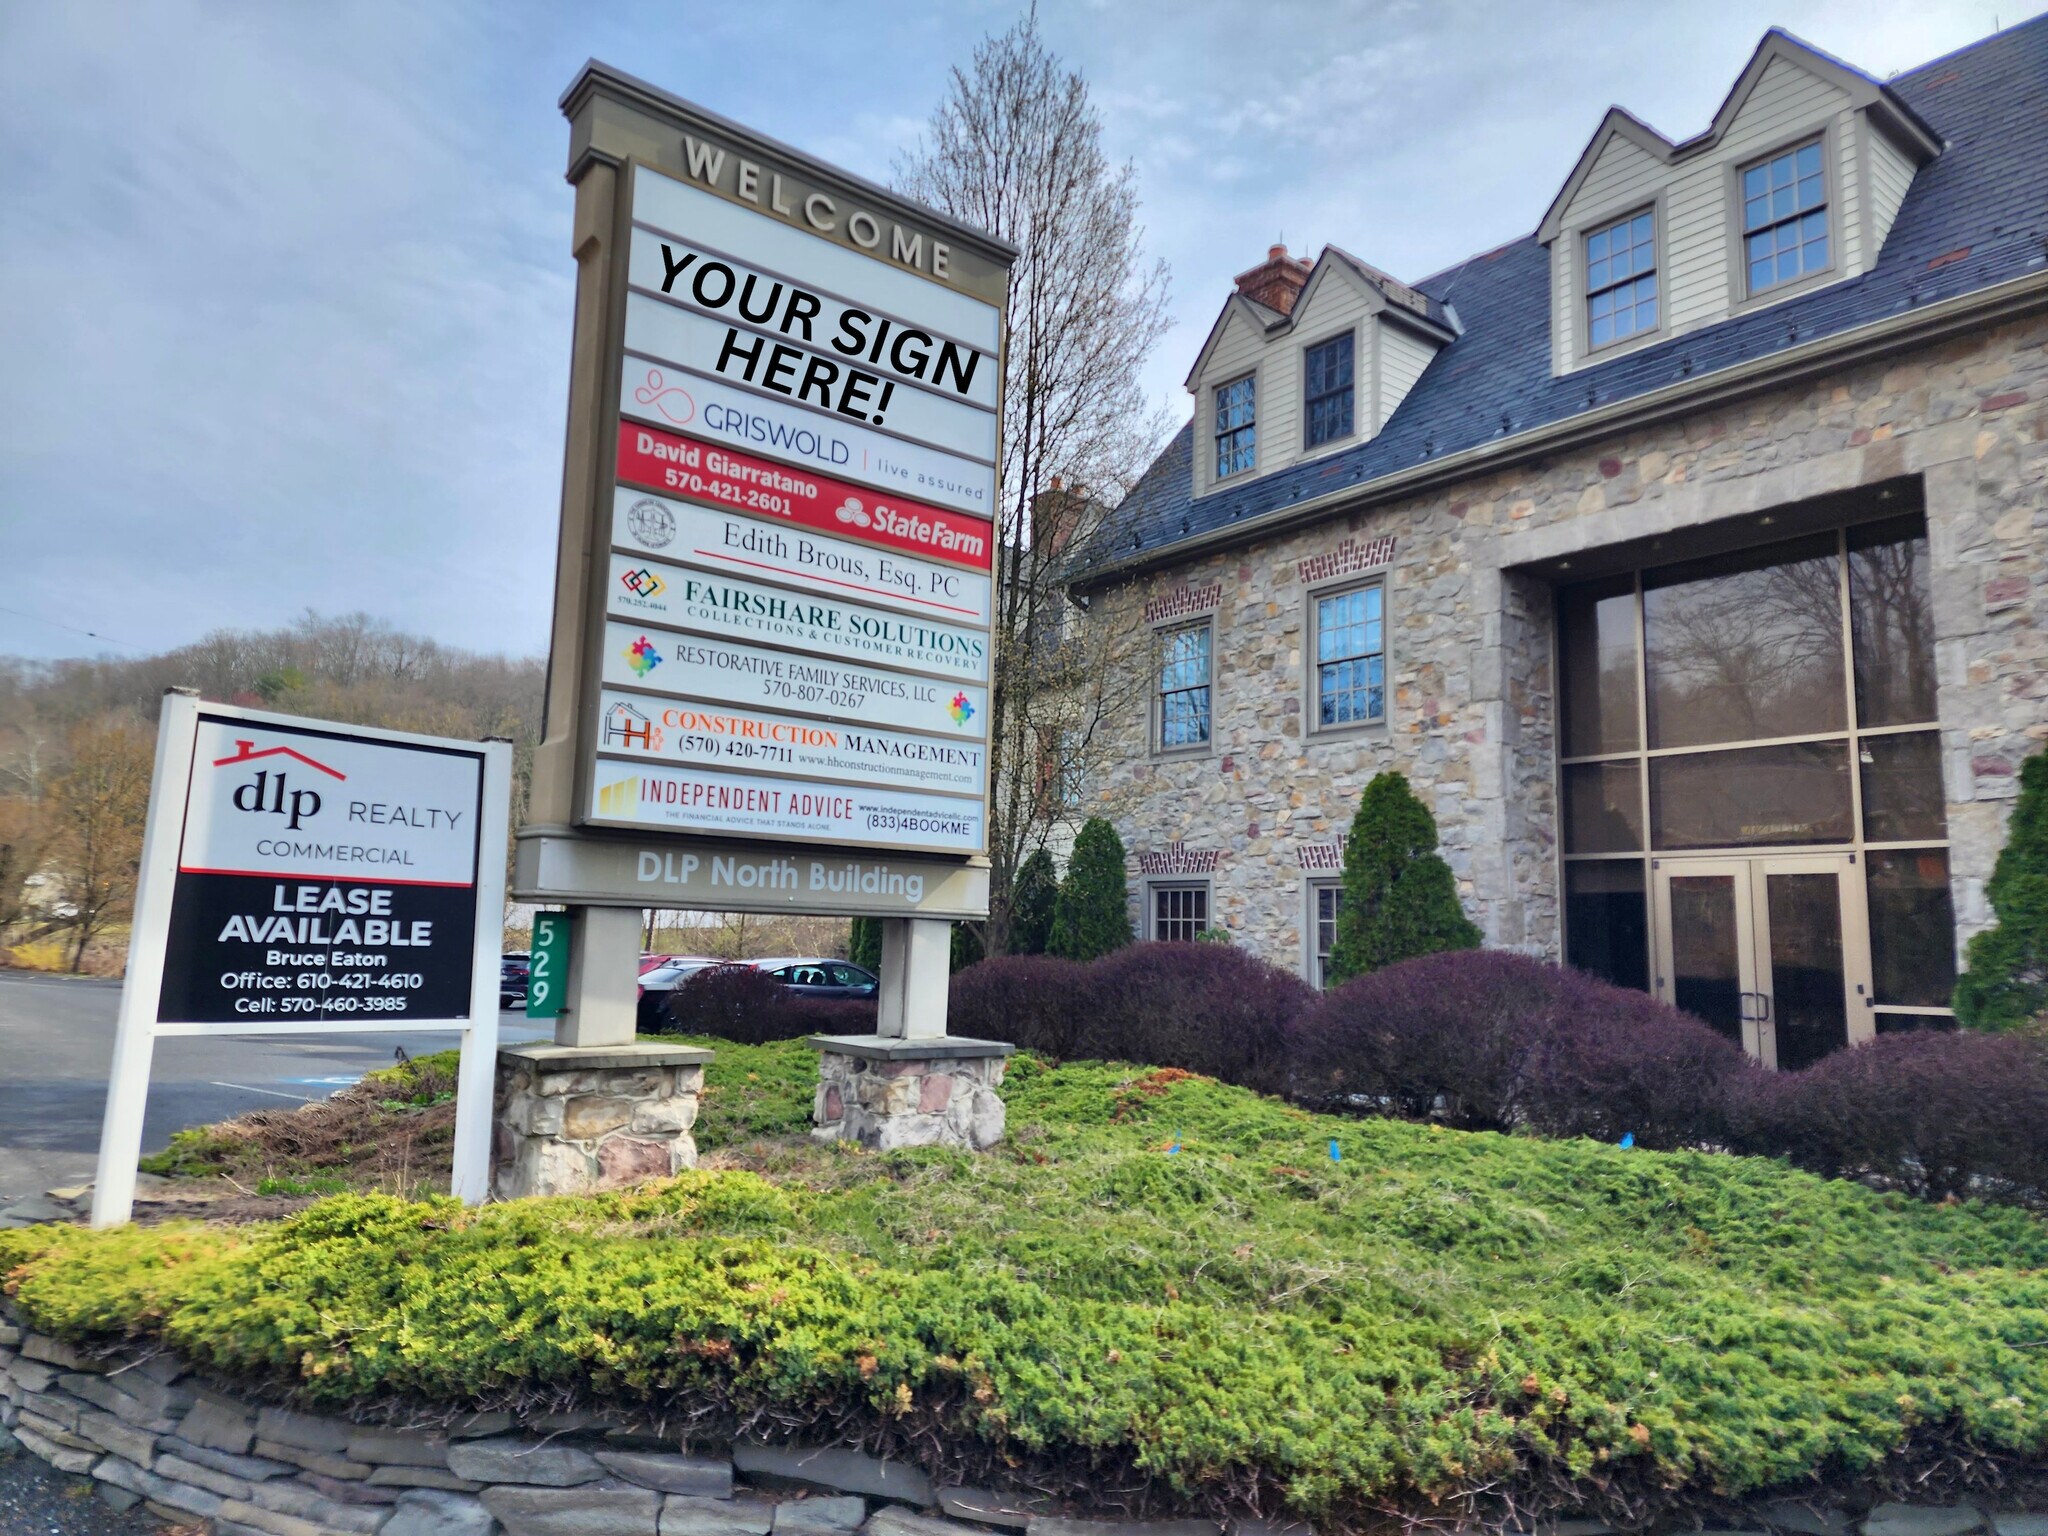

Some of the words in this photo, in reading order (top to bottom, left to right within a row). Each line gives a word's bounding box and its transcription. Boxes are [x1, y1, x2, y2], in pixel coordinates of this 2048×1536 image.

[684, 136, 950, 279] WELCOME
[704, 403, 849, 466] GRISWOLD
[636, 432, 700, 469] David
[706, 451, 818, 499] Giarratano
[878, 458, 909, 478] live
[917, 471, 984, 500] assured
[665, 469, 791, 516] 570-421-2601
[724, 522, 788, 559] Edith
[798, 544, 870, 581] Brous,
[878, 560, 921, 597] Esq.
[930, 572, 960, 598] PC
[685, 580, 841, 631] FAIRSHARE
[849, 614, 983, 659] SOLUTIONS
[687, 606, 804, 637] COLLECTIONS
[808, 629, 818, 639] &
[824, 632, 903, 656] CUSTOMER
[907, 647, 980, 671] RECOVERY
[676, 645, 784, 678] RESTORATIVE
[789, 664, 839, 689] FAMILY
[843, 674, 908, 701] SERVICES,
[914, 684, 937, 703] LLC
[762, 679, 865, 710] 570-807-0267
[662, 708, 838, 748] CONSTRUCTION
[843, 734, 982, 767] MANAGEMENT
[678, 734, 721, 757] (570)
[725, 741, 794, 763] 420-7711
[799, 753, 972, 784] www.hhconstructionmanagement.com
[232, 770, 322, 830] dlp
[349, 801, 463, 830] REALTY
[641, 779, 782, 814] INDEPENDENT
[789, 795, 854, 820] ADVICE
[665, 811, 680, 819] THE
[682, 812, 724, 823] FINANCIAL
[726, 816, 754, 825] ADVICE
[777, 820, 806, 829] STANDS
[867, 814, 970, 836] (833)4BOOKME
[256, 839, 415, 866] COMMERCIAL
[637, 851, 699, 884] DLP
[711, 855, 798, 889] North
[809, 863, 924, 902] Building
[273, 884, 393, 916] LEASE
[217, 915, 433, 947] AVAILABLE
[266, 950, 326, 967] Bruce
[331, 951, 387, 968] Eaton
[220, 972, 292, 991] Office:
[296, 973, 424, 990] 610-421-4610
[234, 997, 276, 1014] Cell:
[281, 997, 407, 1013] 570-460-3985
